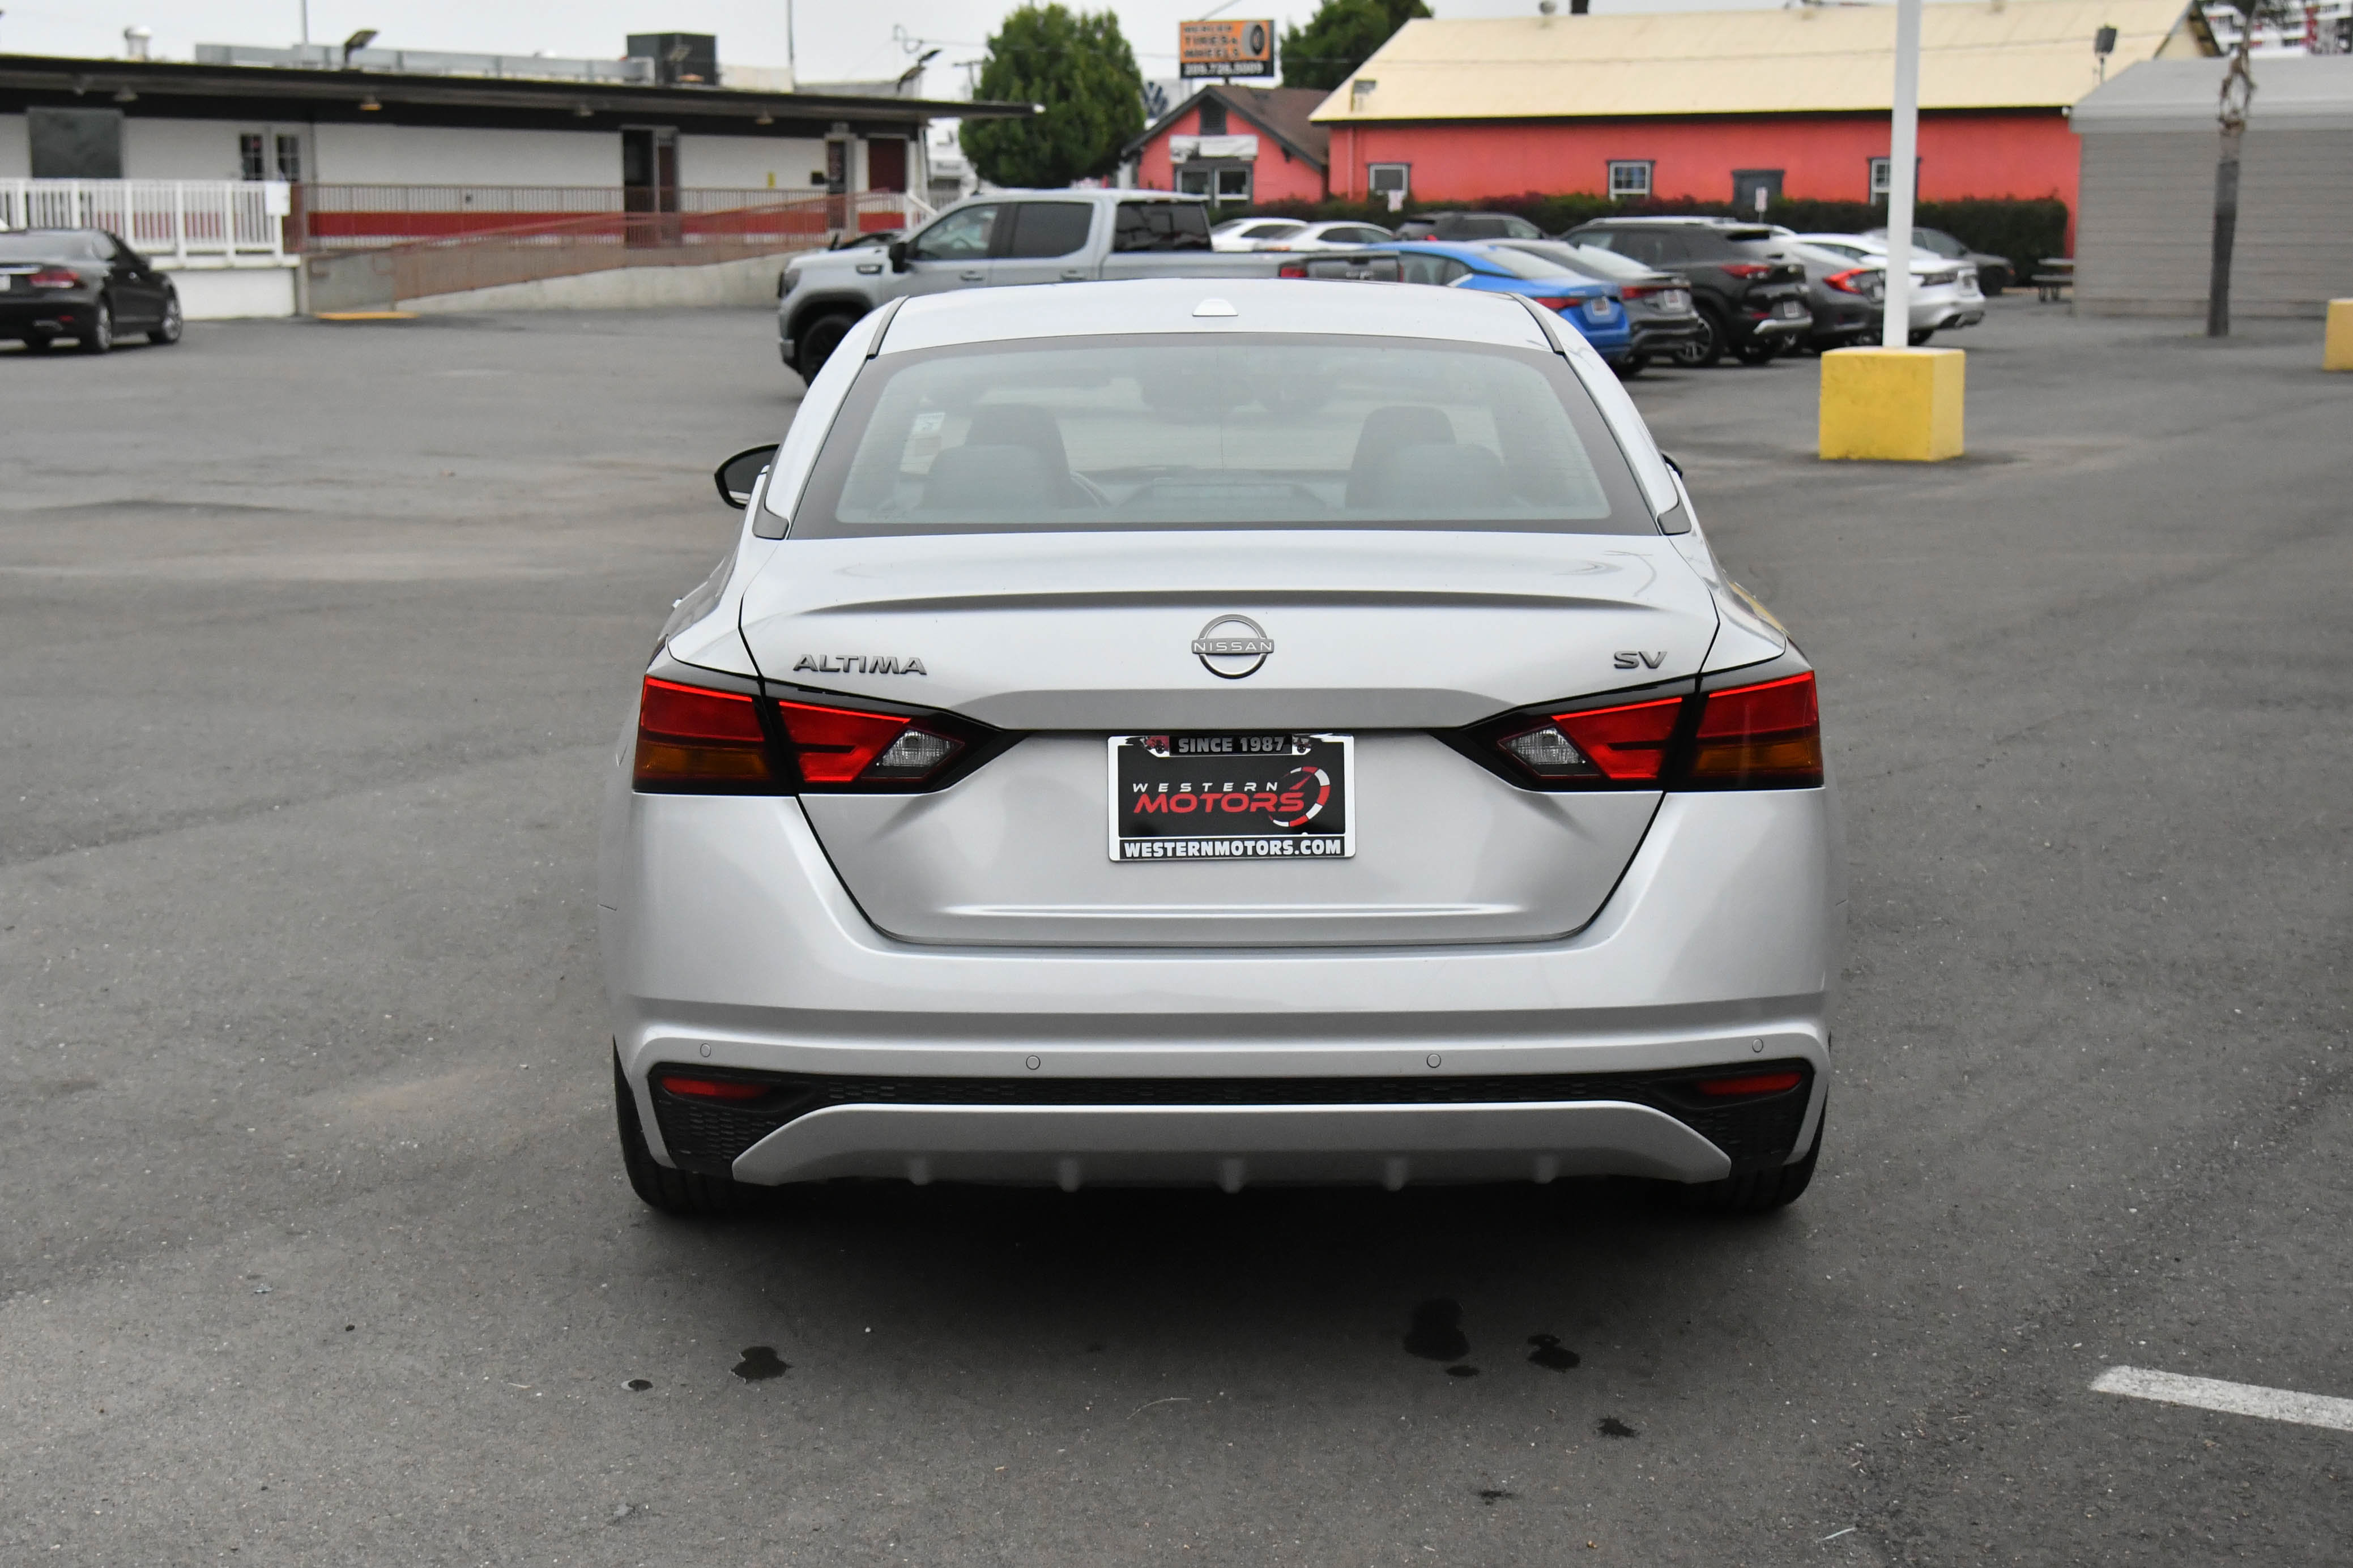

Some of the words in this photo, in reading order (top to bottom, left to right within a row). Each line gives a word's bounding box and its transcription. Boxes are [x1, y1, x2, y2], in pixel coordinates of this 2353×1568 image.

[1194, 642, 1272, 651] NISSAN
[793, 653, 927, 676] ALTIMA
[1613, 651, 1668, 669] SV
[1178, 737, 1233, 753] SINCE
[1240, 736, 1285, 752] 1987
[1133, 781, 1278, 792] WESTERN
[1133, 792, 1305, 813] MOTORS
[1124, 839, 1341, 858] WESTERNMOTORS.COM
